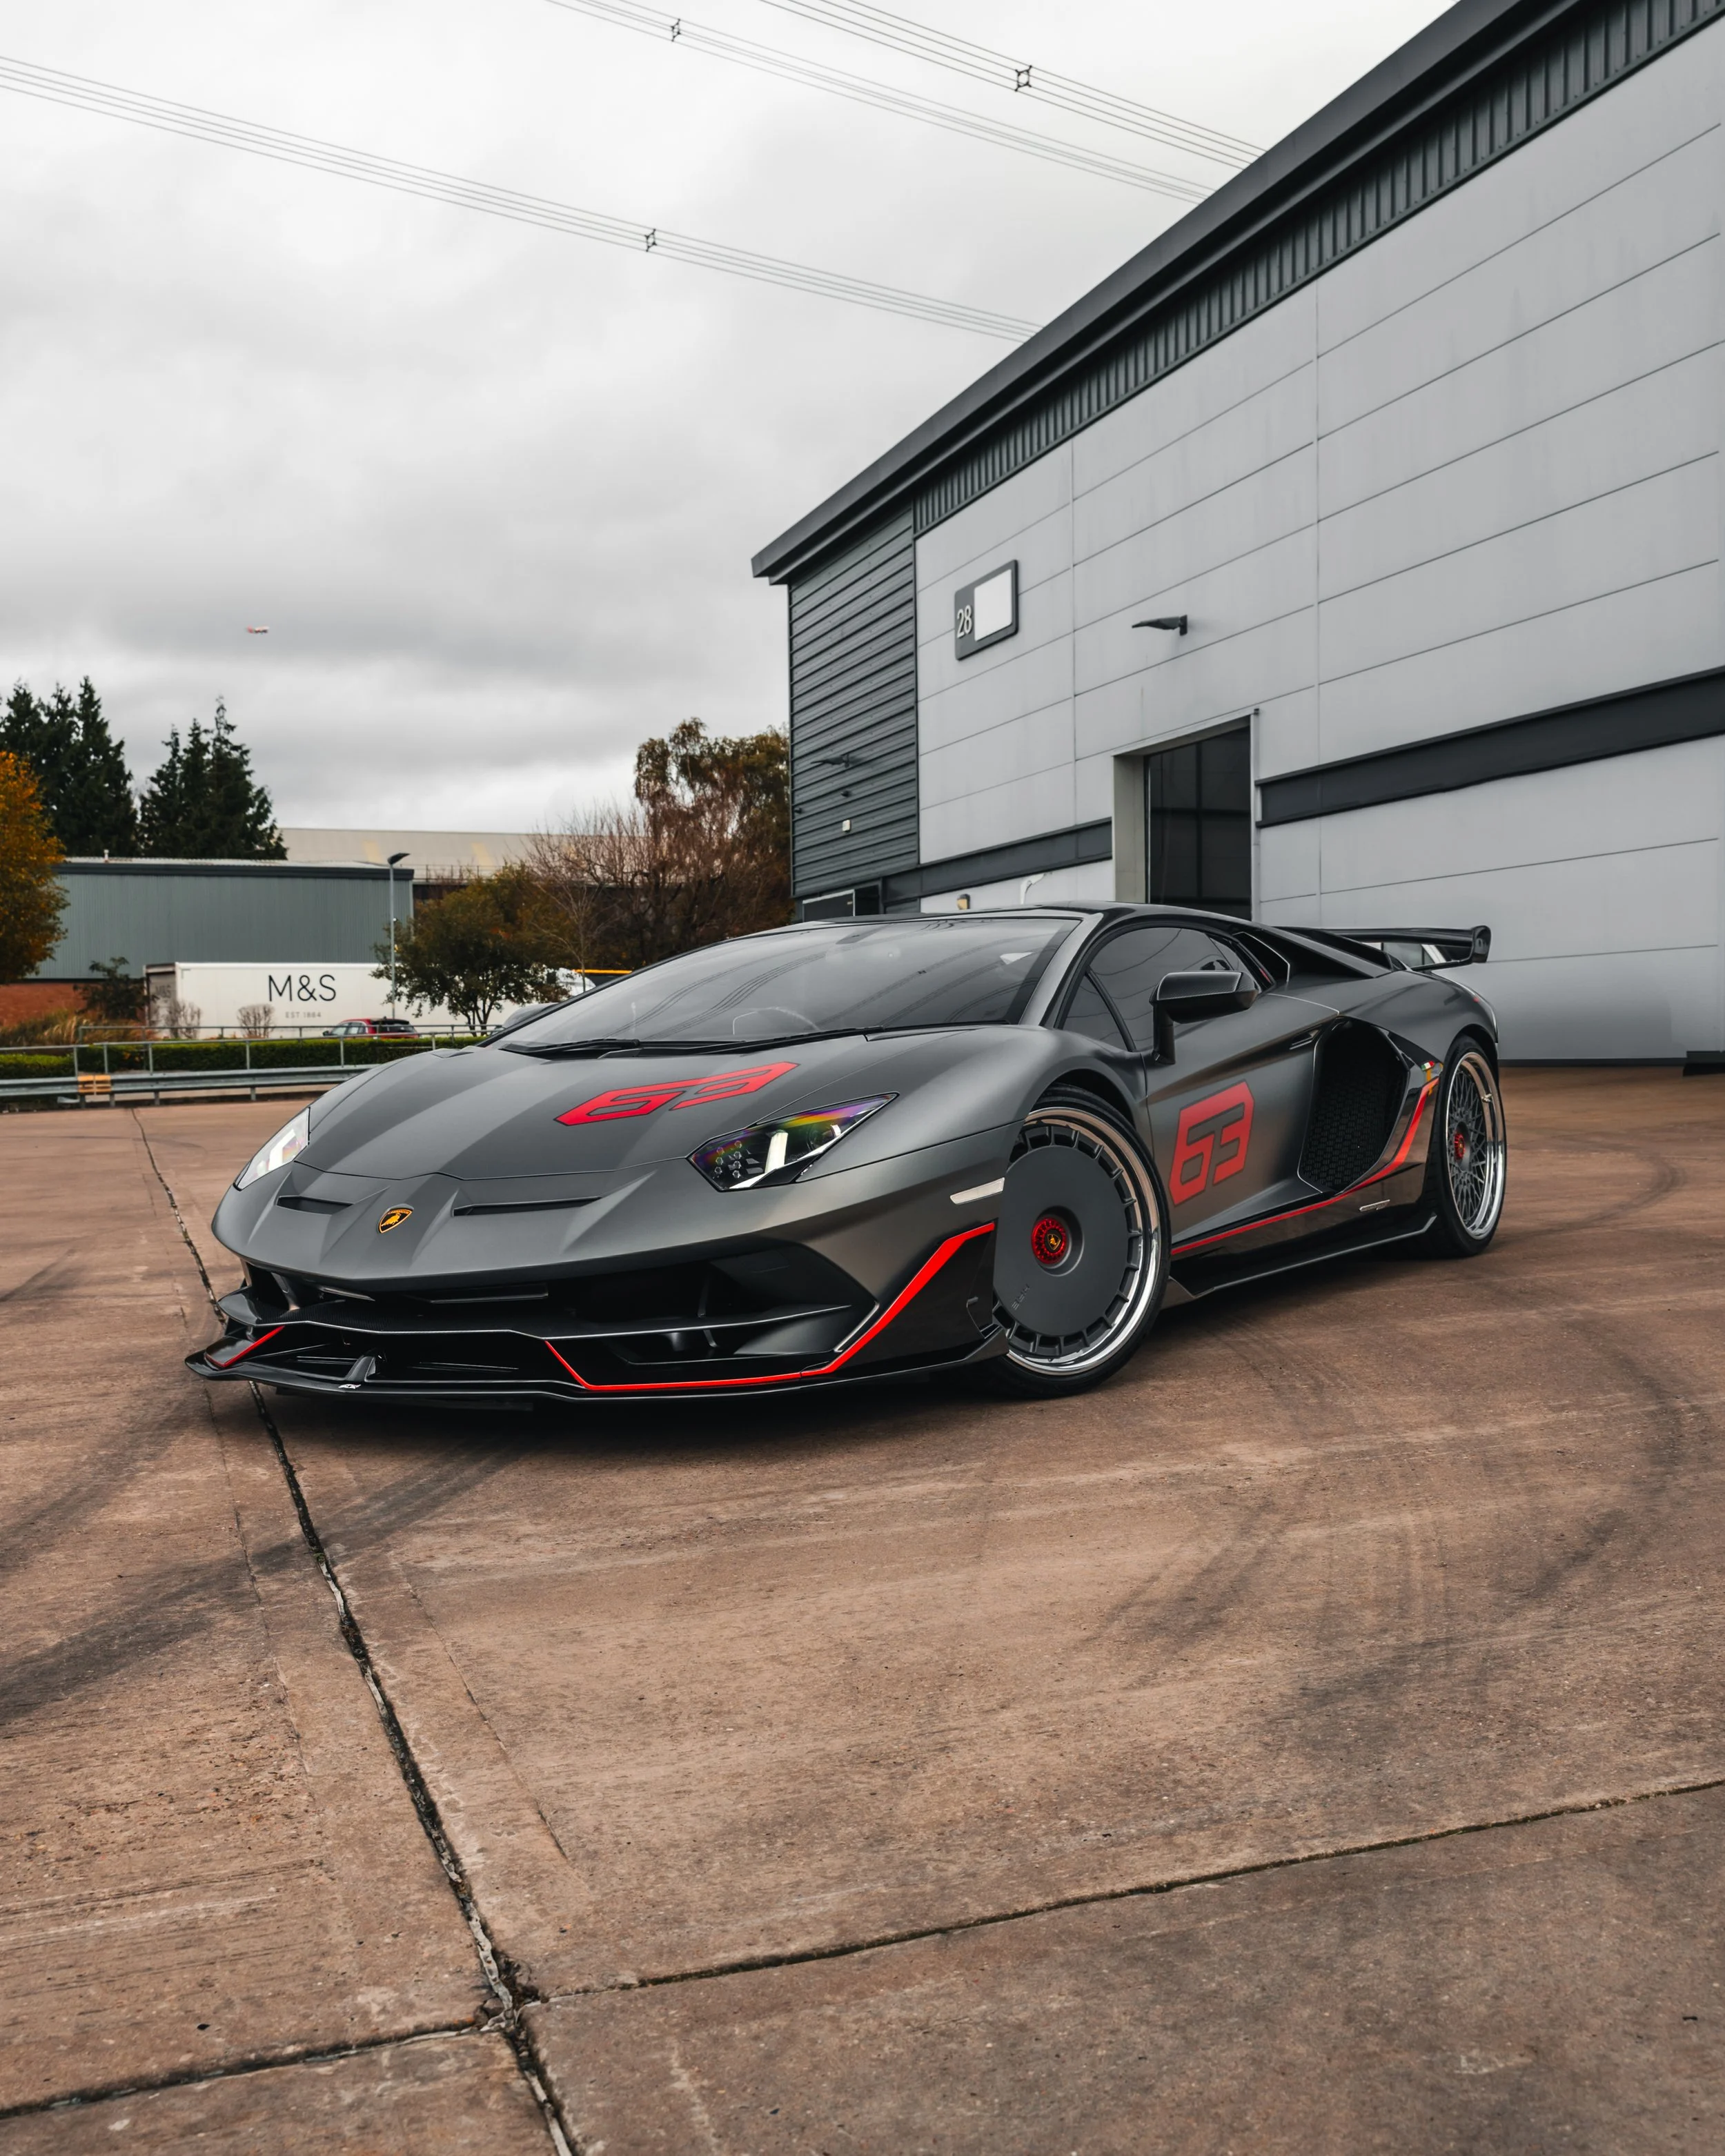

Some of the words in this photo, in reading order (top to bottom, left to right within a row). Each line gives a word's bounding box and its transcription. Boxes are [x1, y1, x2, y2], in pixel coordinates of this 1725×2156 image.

[956, 604, 972, 638] 28
[268, 974, 336, 1002] M&S
[553, 1061, 800, 1126] 63
[1168, 1078, 1254, 1206] 63
